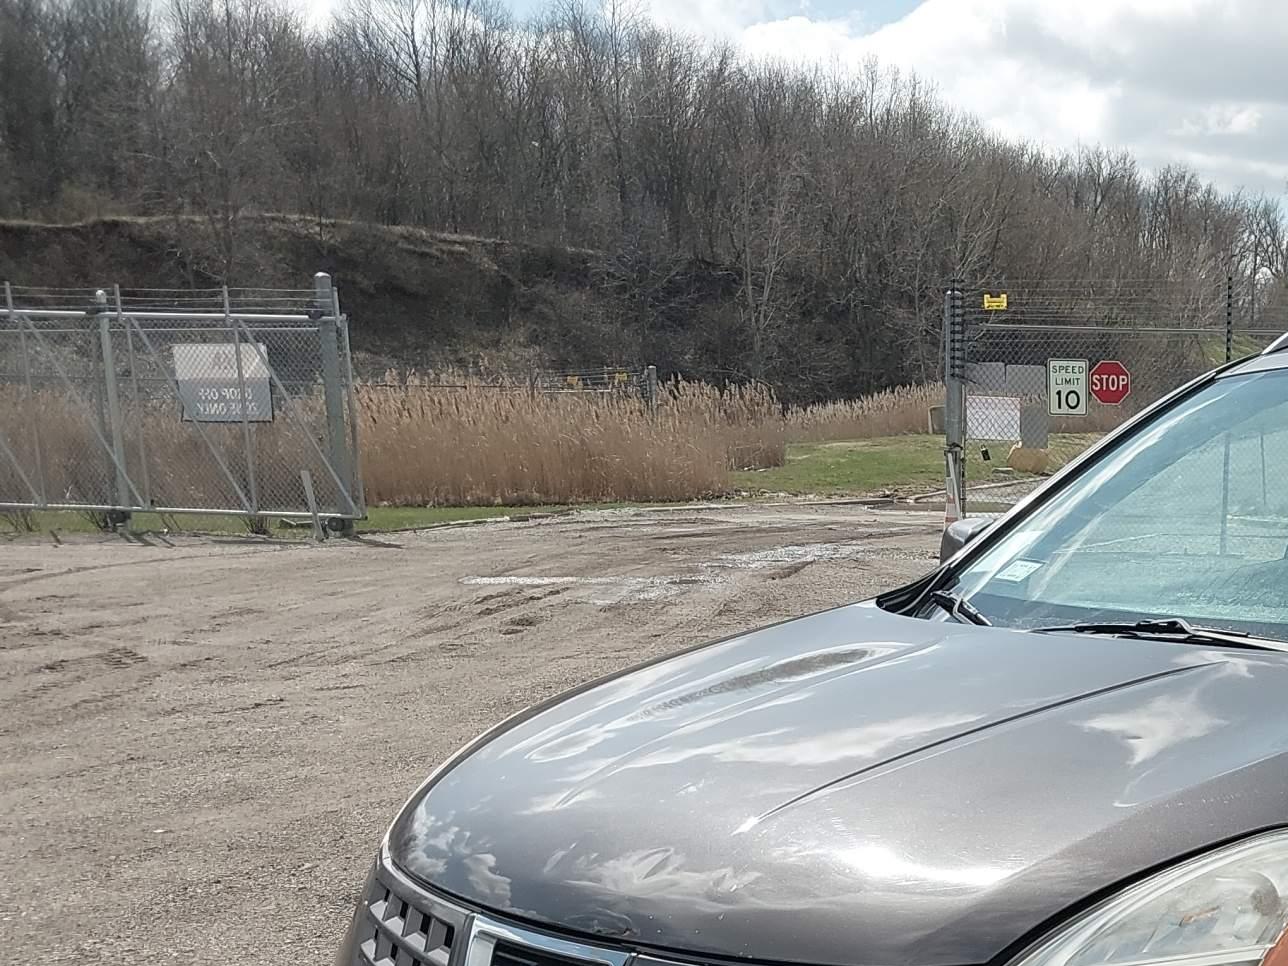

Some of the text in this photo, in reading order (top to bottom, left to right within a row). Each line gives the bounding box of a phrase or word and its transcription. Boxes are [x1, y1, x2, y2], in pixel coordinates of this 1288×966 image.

[1052, 365, 1085, 374] SPEED
[1056, 377, 1081, 386] LIMIT
[1092, 374, 1128, 391] STOP
[1056, 389, 1080, 410] 10
